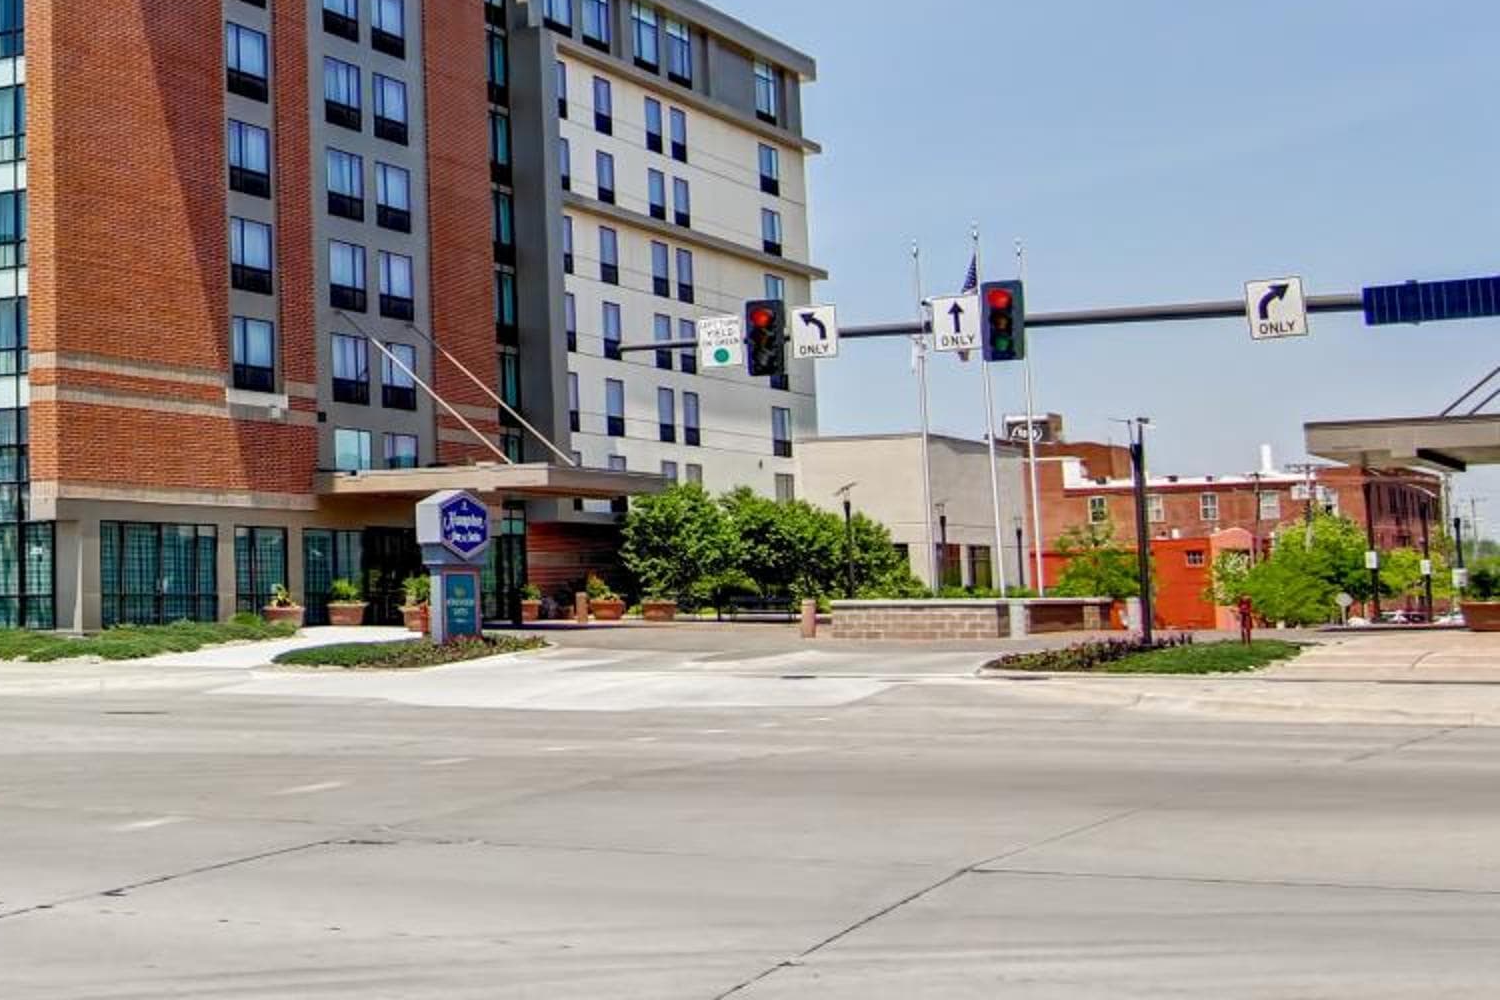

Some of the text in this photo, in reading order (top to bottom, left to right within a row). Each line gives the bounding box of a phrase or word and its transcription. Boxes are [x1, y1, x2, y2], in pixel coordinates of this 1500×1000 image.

[1259, 320, 1295, 335] ONLY
[940, 333, 975, 347] ONLY
[799, 344, 829, 356] ONLY
